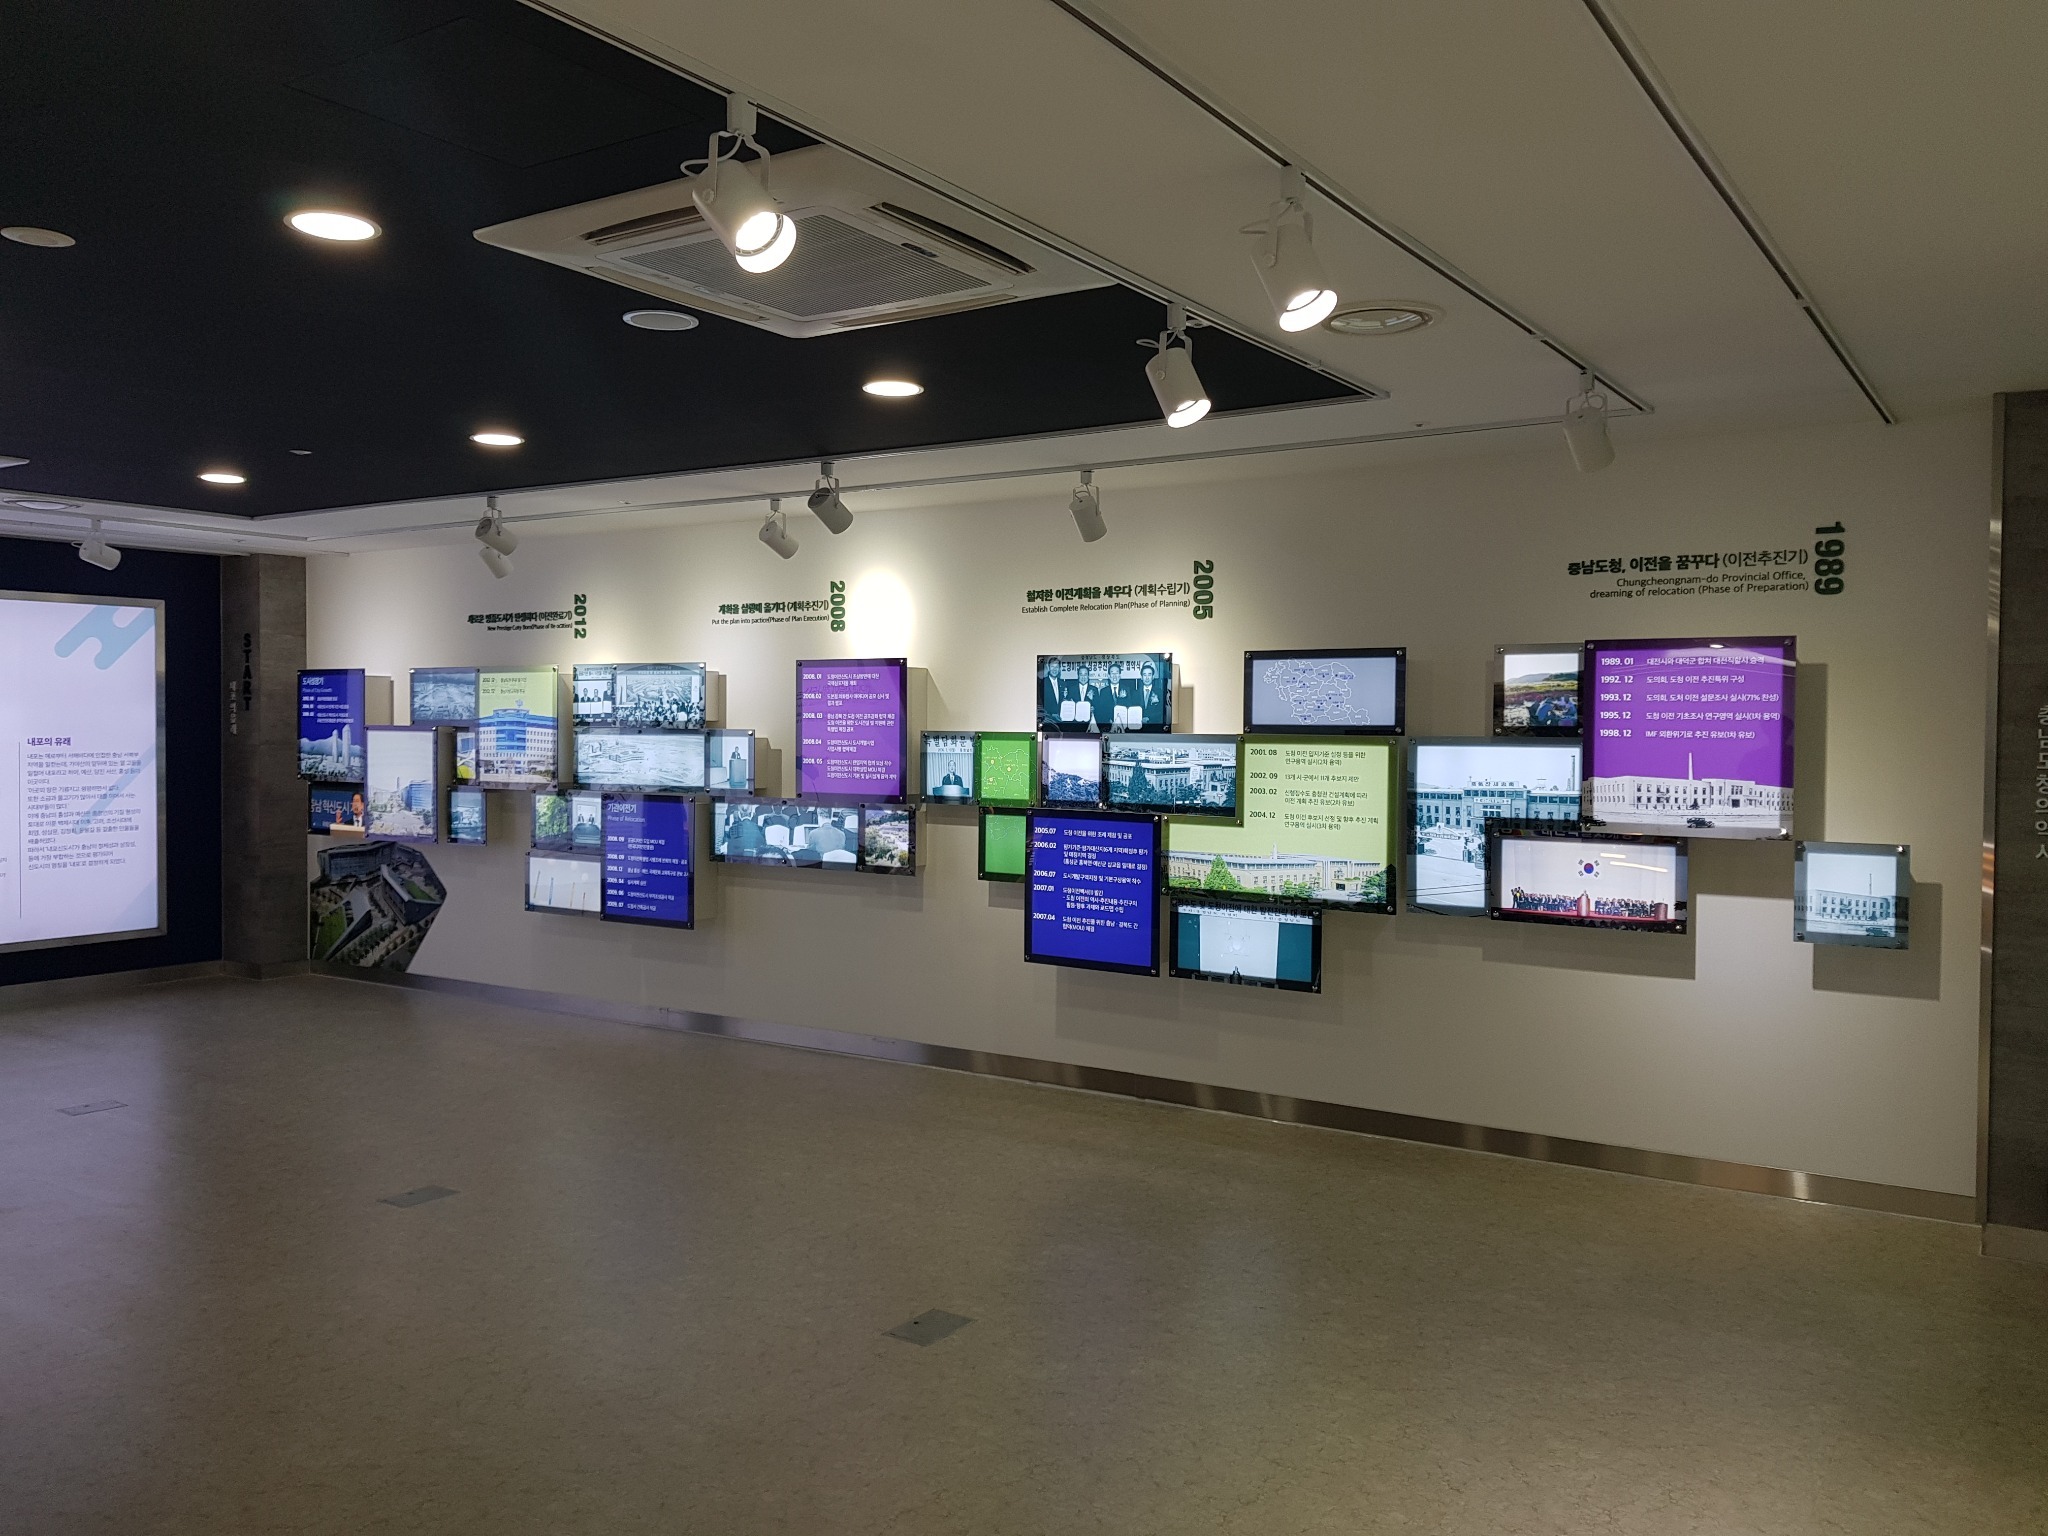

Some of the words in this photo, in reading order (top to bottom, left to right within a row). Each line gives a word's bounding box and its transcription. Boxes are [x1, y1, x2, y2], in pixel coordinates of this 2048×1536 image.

[1630, 556, 1672, 572] 이전을
[1676, 553, 1719, 570] 꿈꾸다
[1723, 549, 1808, 567] (이전추진기)
[1814, 521, 1845, 595] 1989
[1616, 574, 1718, 587] Chungcheongnam-do
[1722, 572, 1769, 582] Provincial
[1773, 571, 1805, 581] Office,
[1055, 586, 1101, 601] 이전계획을
[1103, 585, 1132, 598] 세우다
[1193, 560, 1214, 619] 2005
[1590, 589, 1632, 599] dreaming
[1636, 588, 1645, 596] of
[1648, 586, 1694, 596] relocation
[1698, 584, 1731, 595] (Phase
[1734, 583, 1744, 592] of
[1746, 581, 1809, 593] Preparation)
[830, 581, 845, 632] 2008
[1050, 604, 1078, 613] Complete
[574, 594, 586, 639] 2012
[1624, 657, 1633, 666] 01
[243, 633, 251, 710] START
[1624, 676, 1633, 684] 12
[1686, 676, 1699, 684] 이전
[1731, 676, 1745, 684] 구성
[1600, 694, 1621, 702] 1993.
[1623, 694, 1631, 702] 12
[1685, 694, 1699, 702] 이전
[1623, 712, 1631, 720] 12
[1661, 712, 1675, 720] 이전
[27, 737, 52, 746] 내포의
[54, 737, 71, 746] 유래
[1623, 730, 1631, 738] 12
[1646, 730, 1658, 738] IMF
[1695, 730, 1708, 738] 추진
